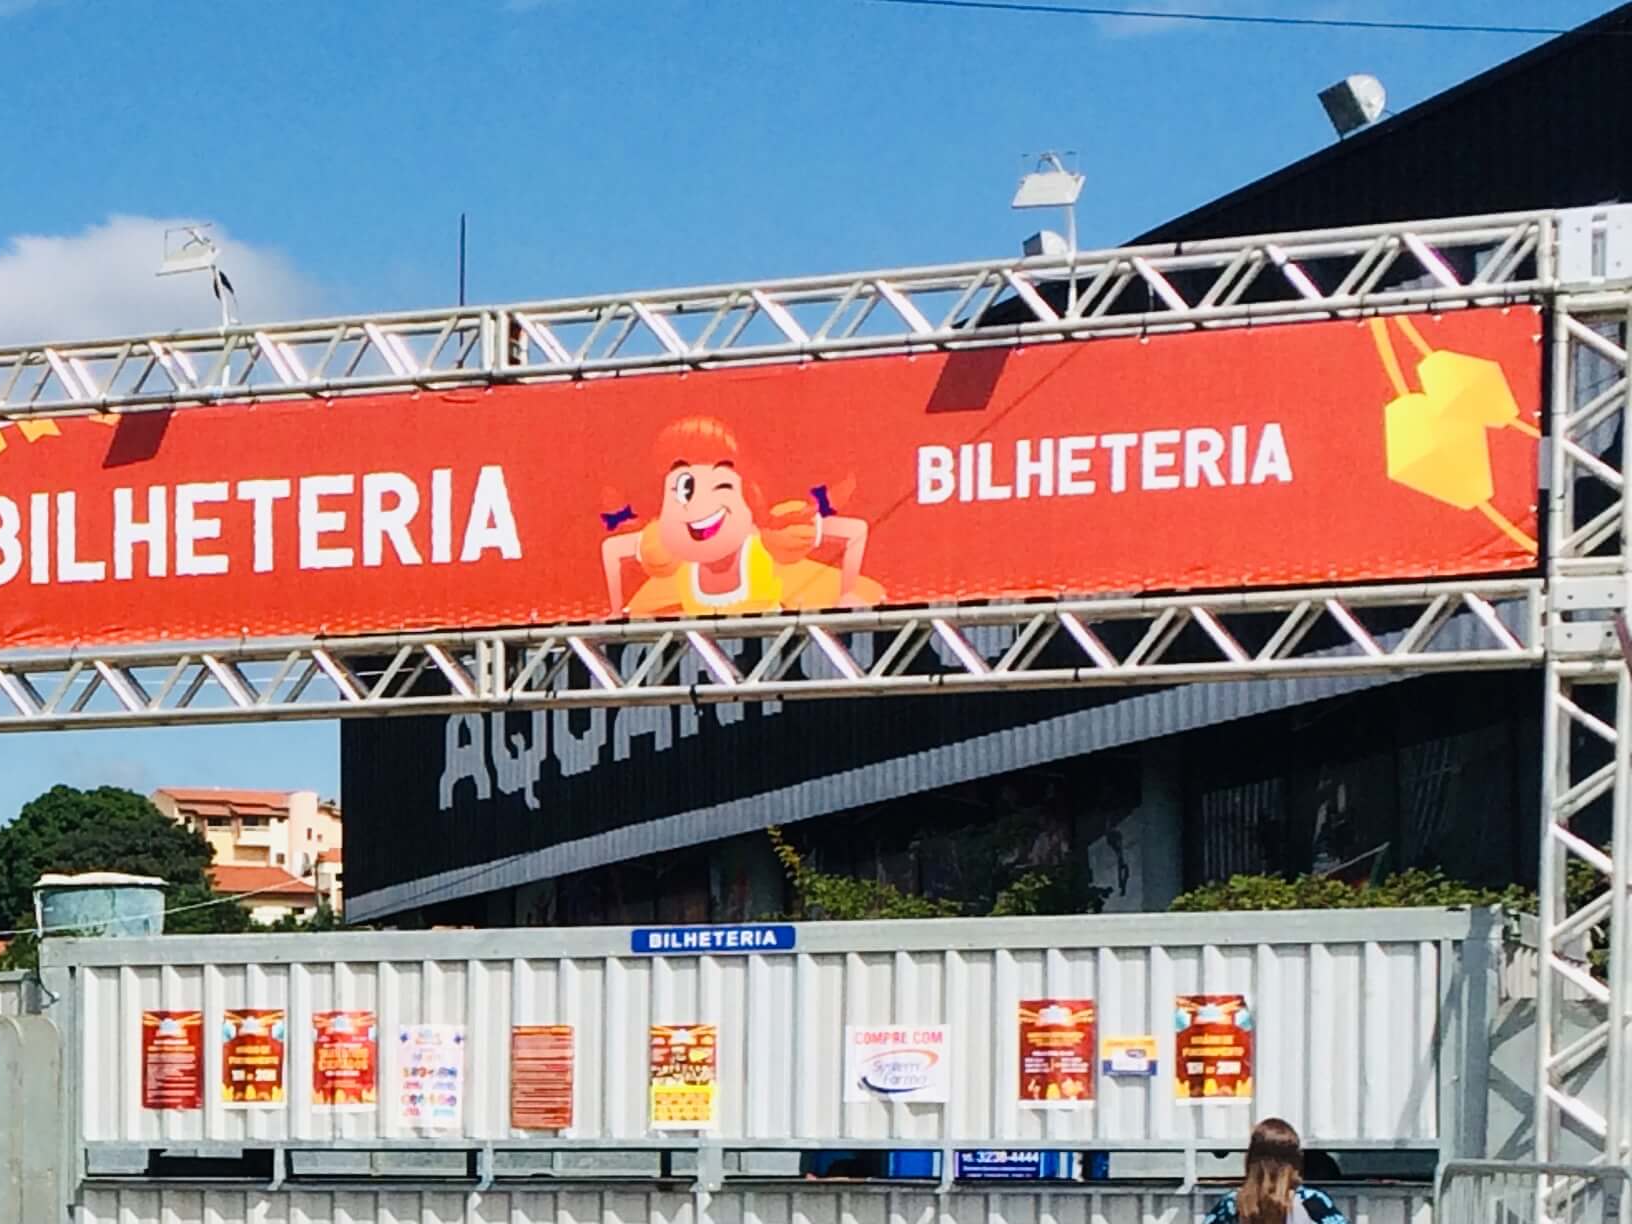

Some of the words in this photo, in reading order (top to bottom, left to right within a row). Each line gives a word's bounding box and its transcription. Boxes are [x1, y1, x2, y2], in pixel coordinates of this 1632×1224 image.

[917, 422, 1293, 505] BILHETERIA
[647, 929, 778, 949] BILHETERIA
[854, 1030, 908, 1046] COMPRE
[912, 1030, 944, 1045] COM
